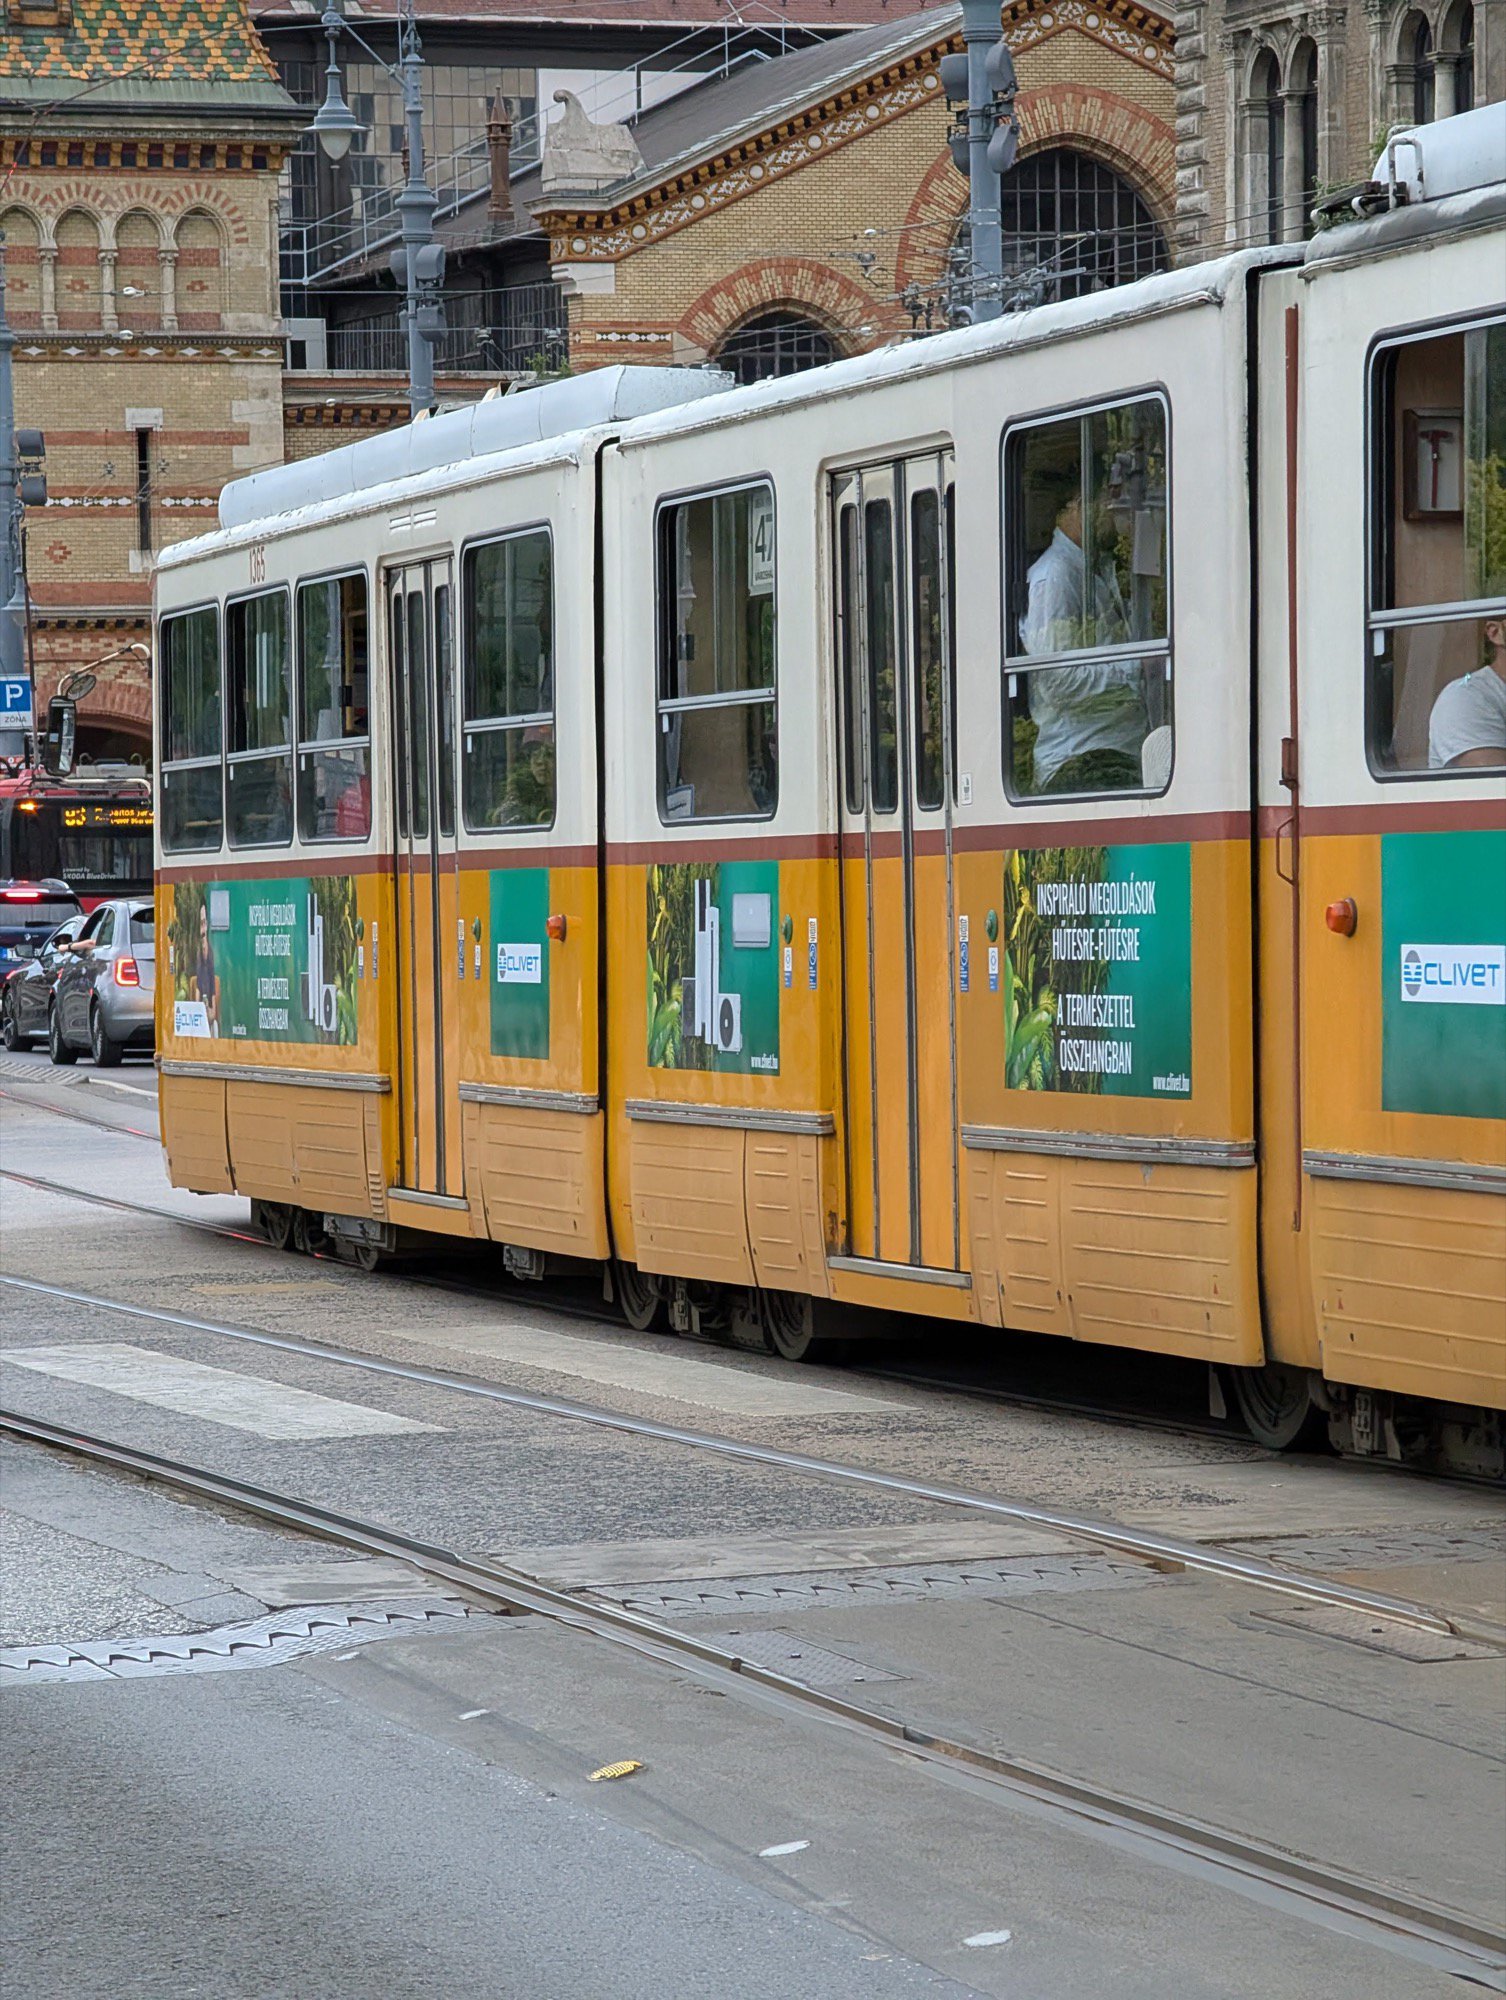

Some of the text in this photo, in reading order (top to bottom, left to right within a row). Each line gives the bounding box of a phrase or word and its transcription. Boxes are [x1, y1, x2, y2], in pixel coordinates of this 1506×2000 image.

[249, 546, 265, 584] 1365
[6, 684, 23, 708] P
[1036, 872, 1156, 915] INSPIRÁLÓ MEGOLDÁSOK
[1056, 986, 1135, 1028] A TERMÉSZETTEL
[1060, 1031, 1132, 1074] ÖSSZHANGBAN
